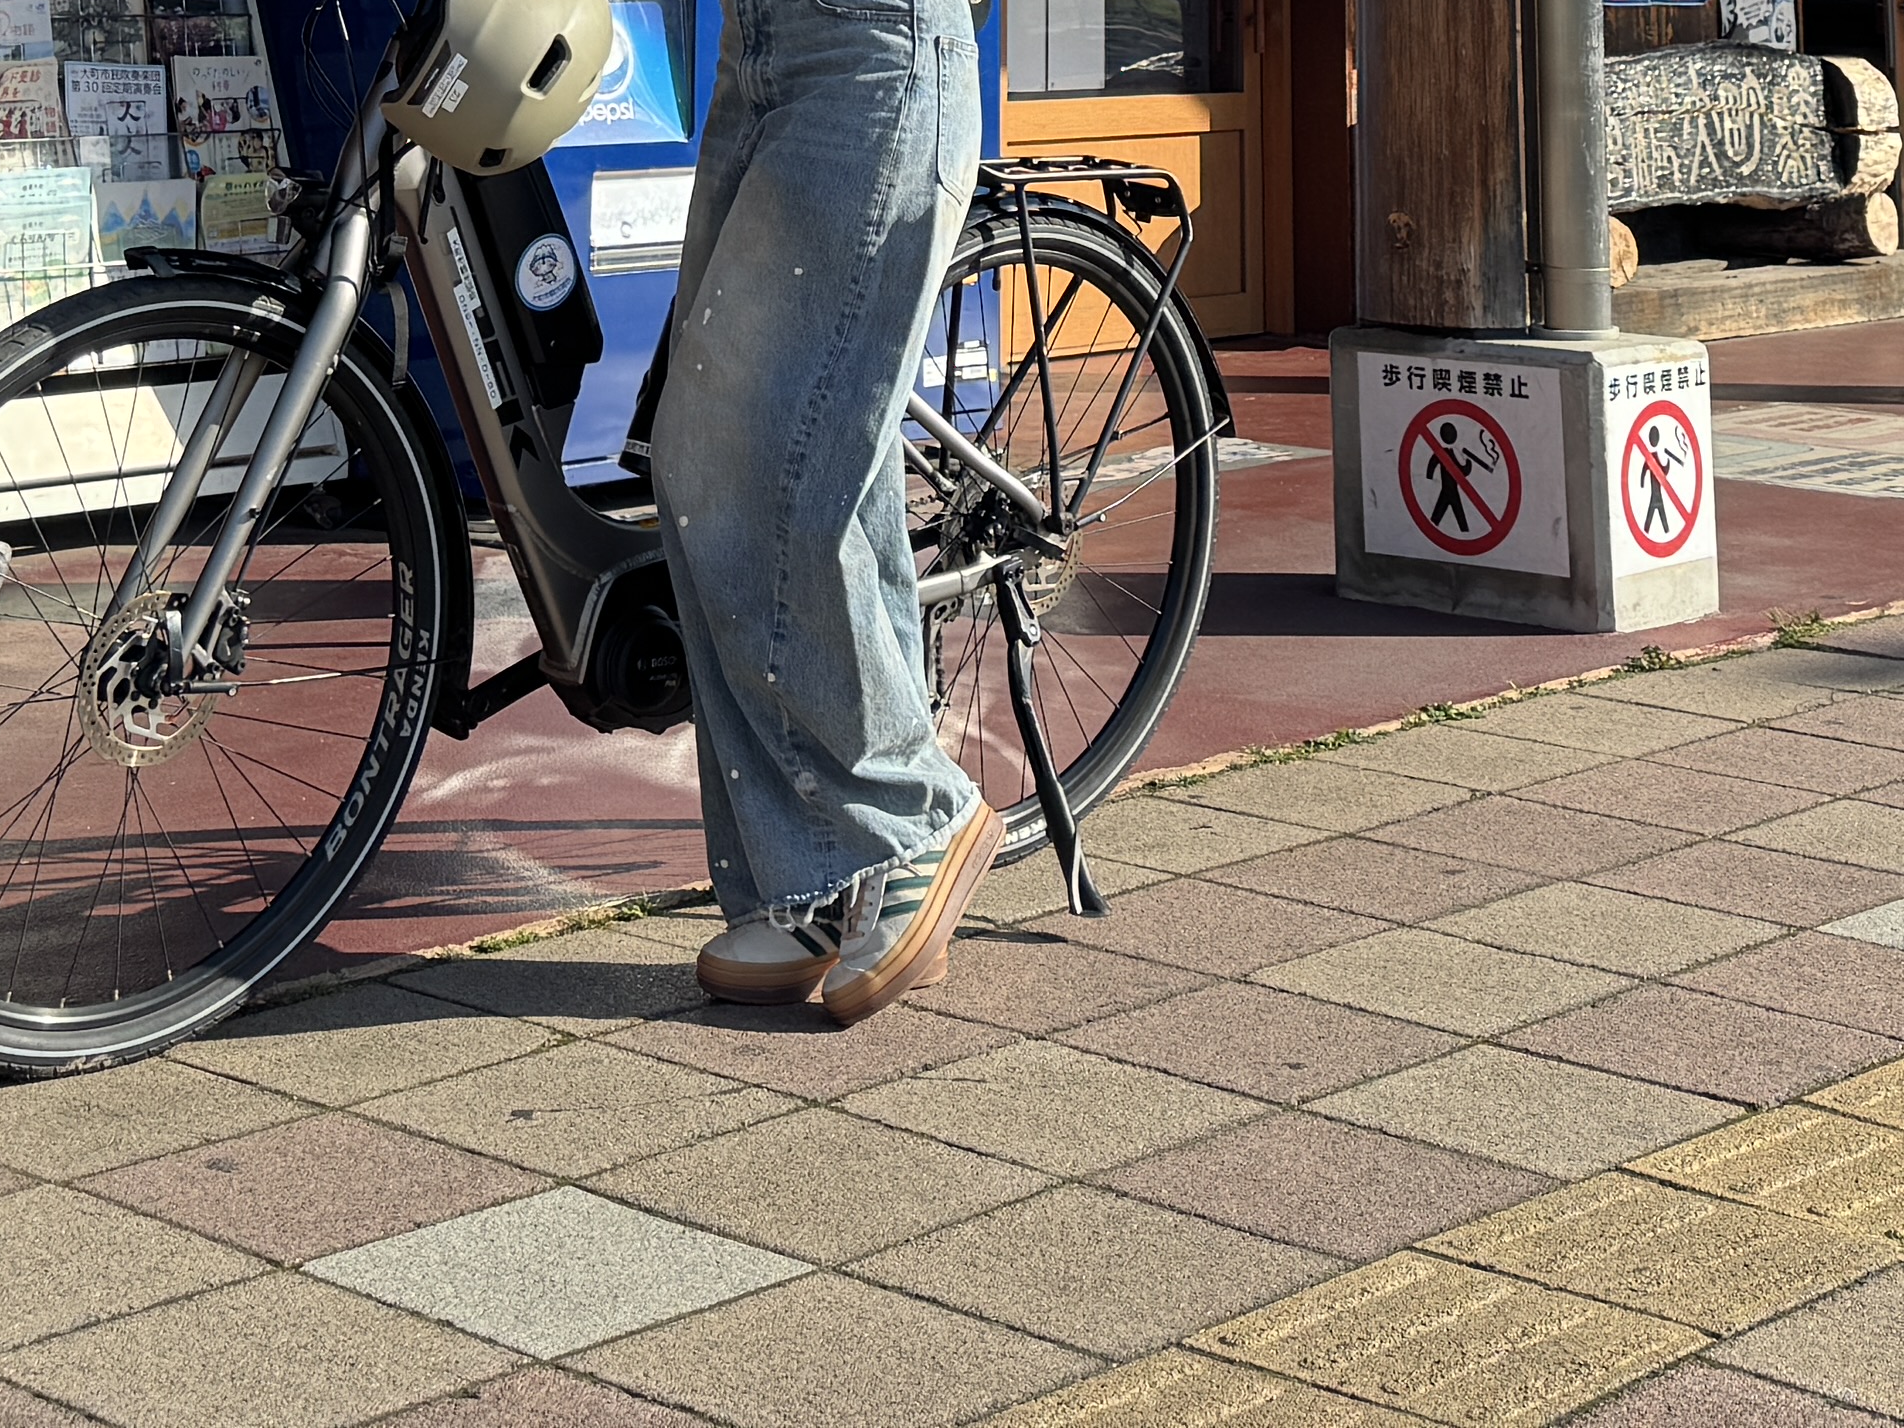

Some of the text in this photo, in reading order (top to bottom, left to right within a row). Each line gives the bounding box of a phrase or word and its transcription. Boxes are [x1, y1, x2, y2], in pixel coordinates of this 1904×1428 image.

[1381, 362, 1530, 400] 歩行喫煙禁止
[1607, 364, 1707, 402] 歩行喫煙禁止
[324, 560, 416, 862] BONTRAGER
